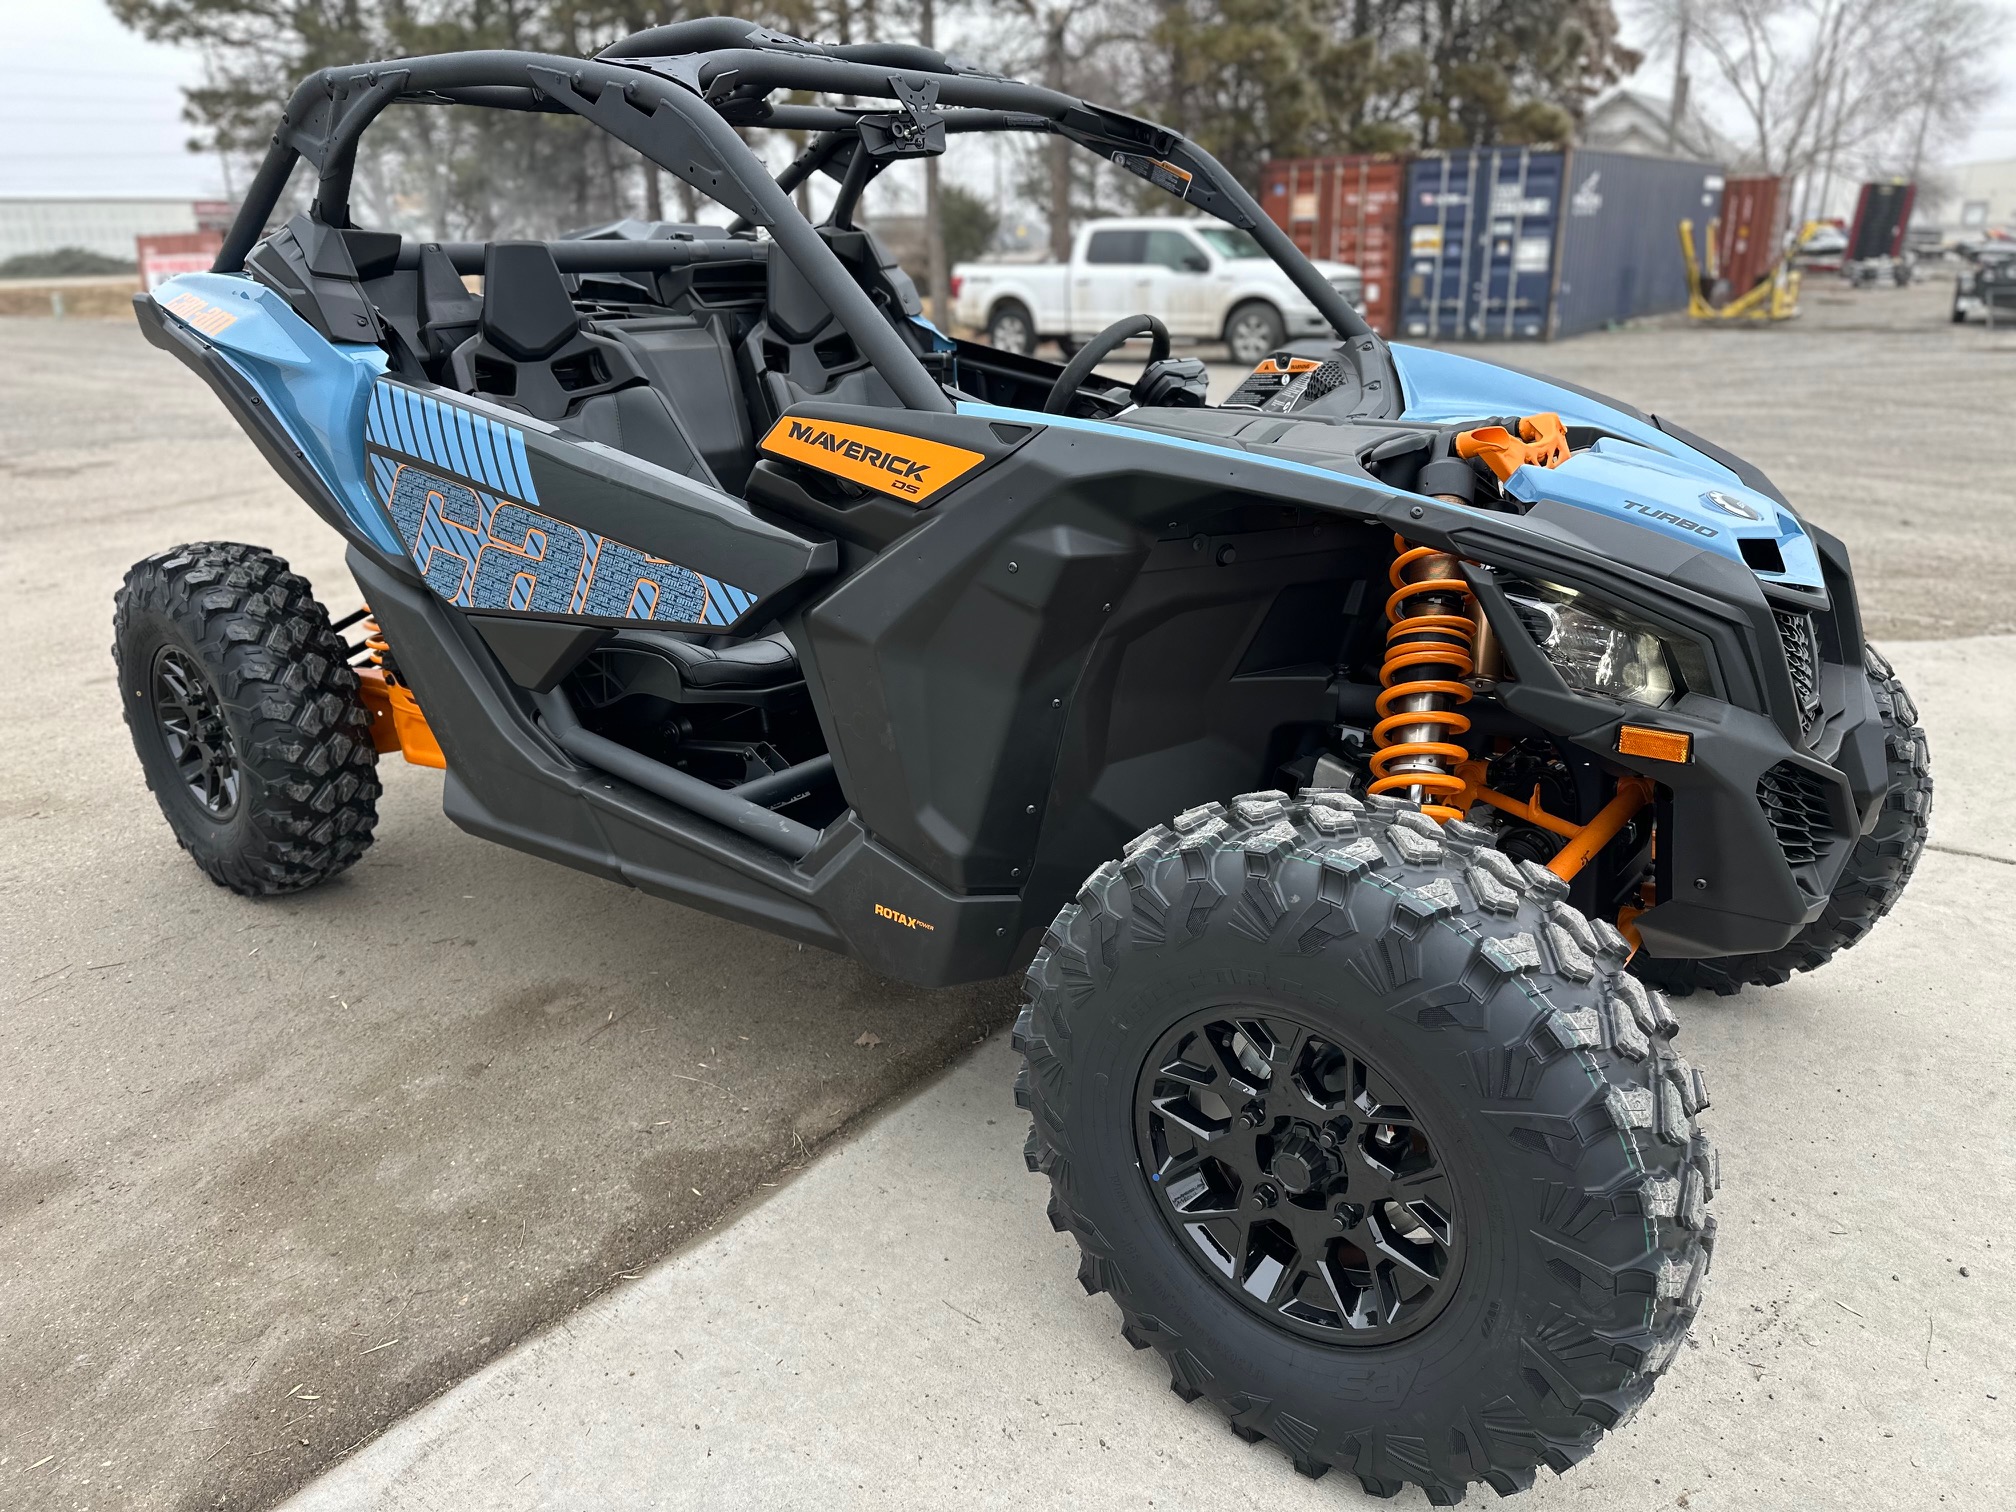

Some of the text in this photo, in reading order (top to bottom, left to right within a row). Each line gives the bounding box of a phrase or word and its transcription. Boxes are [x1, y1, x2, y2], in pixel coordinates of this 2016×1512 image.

[788, 421, 931, 483] MAVERICK
[891, 480, 920, 494] DS
[1623, 500, 1719, 538] TURBO
[875, 904, 917, 930] ROTAX
